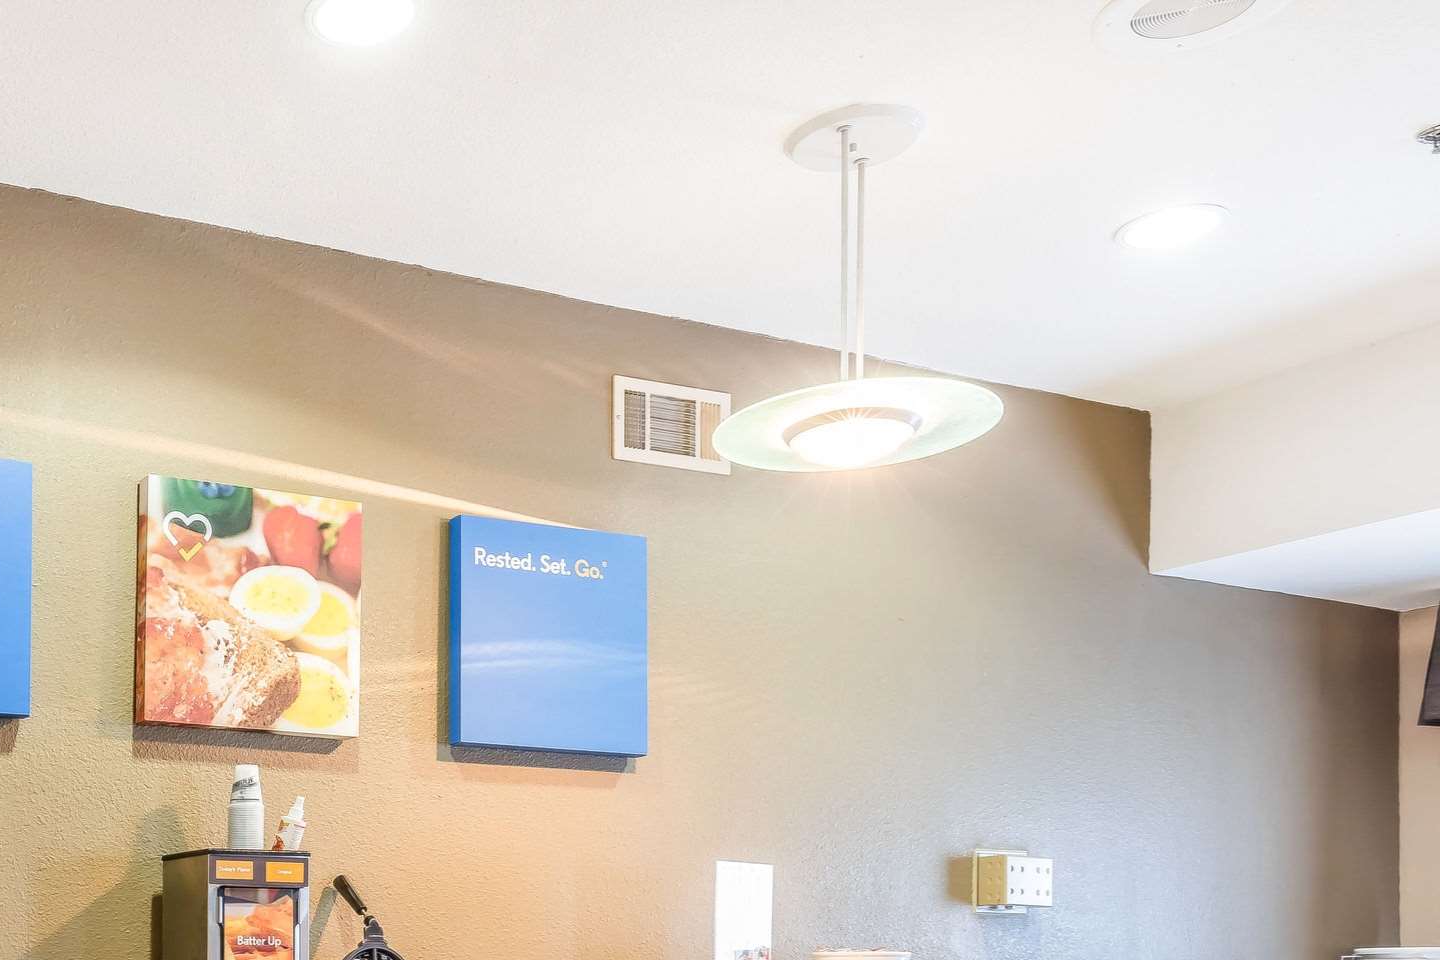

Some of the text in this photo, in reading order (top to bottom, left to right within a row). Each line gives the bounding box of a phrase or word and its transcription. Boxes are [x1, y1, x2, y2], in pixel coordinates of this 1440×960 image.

[474, 546, 537, 572] Rested.
[540, 554, 572, 576] Set.
[237, 935, 282, 949] Batter Up
